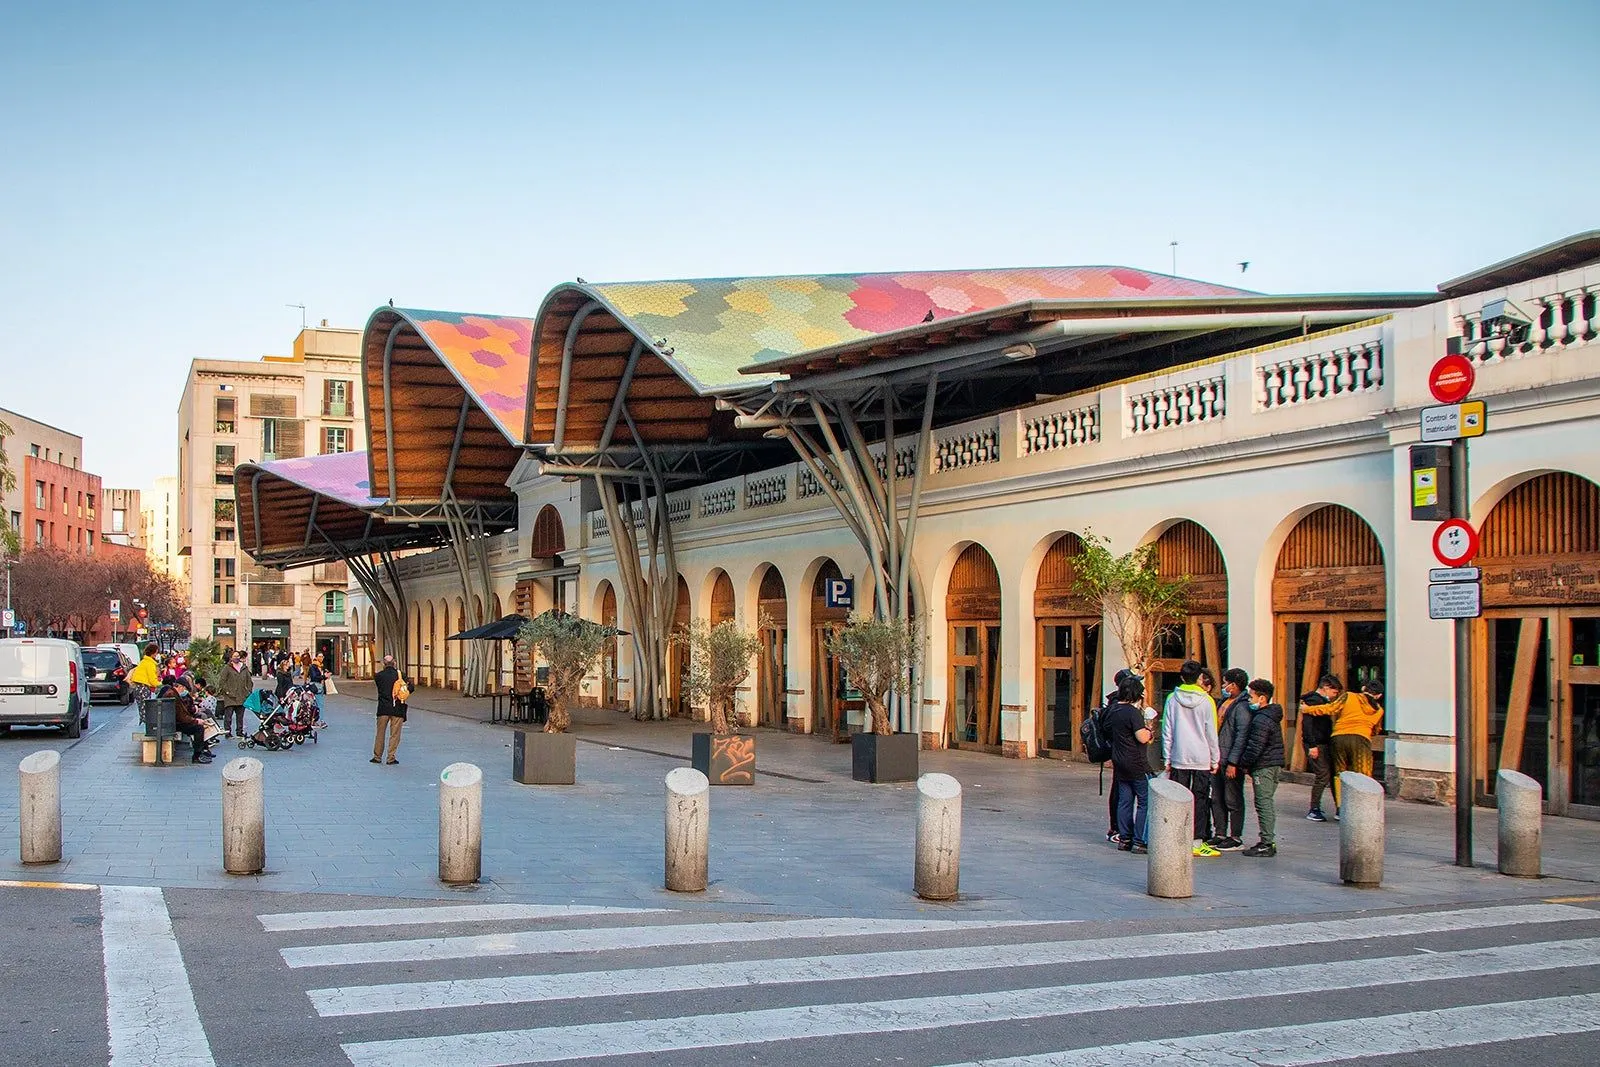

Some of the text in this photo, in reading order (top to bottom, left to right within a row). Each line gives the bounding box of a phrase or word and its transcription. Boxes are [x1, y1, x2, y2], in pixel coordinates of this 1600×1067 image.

[1425, 413, 1447, 423] Control
[1485, 572, 1509, 586] Santa
[832, 581, 846, 602] P
